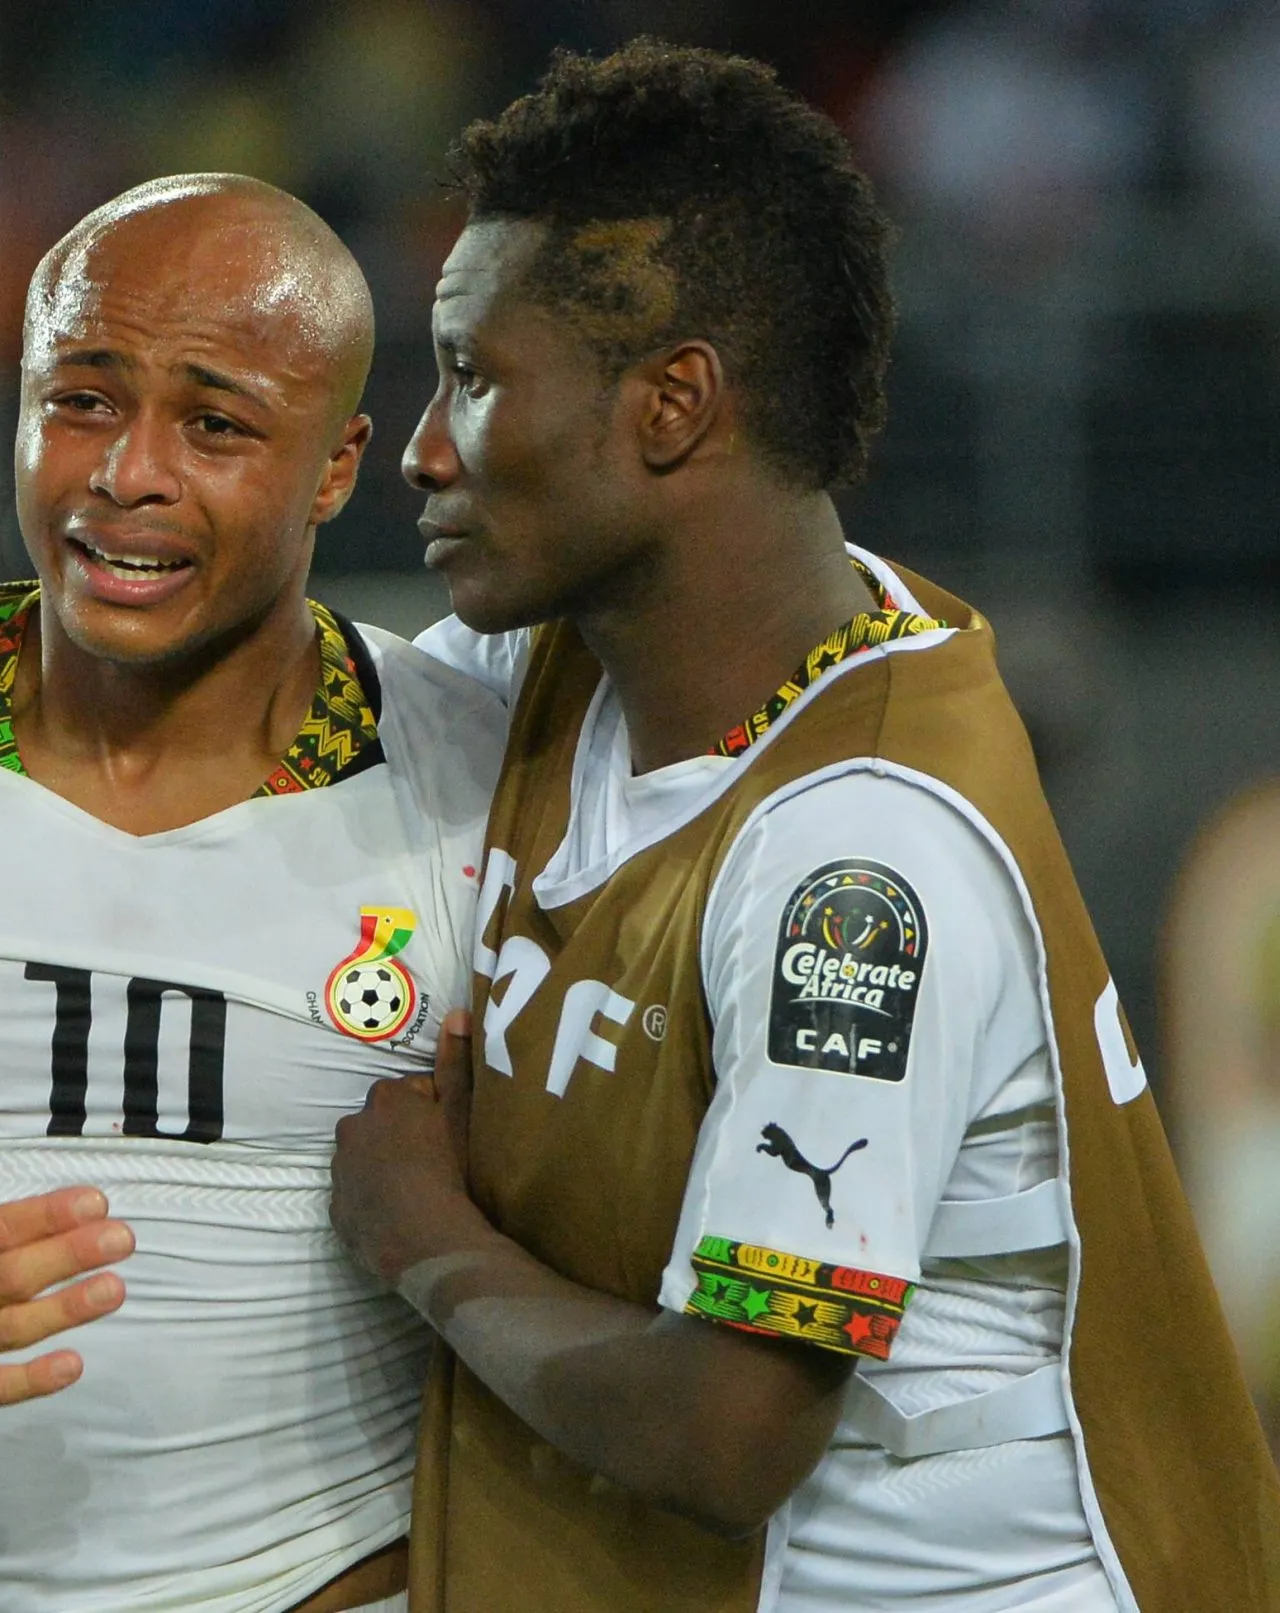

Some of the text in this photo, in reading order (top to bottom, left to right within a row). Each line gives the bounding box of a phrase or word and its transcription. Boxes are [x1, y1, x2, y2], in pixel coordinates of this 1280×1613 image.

[781, 942, 916, 991] Celebrate
[305, 991, 325, 1025] GHAN
[798, 974, 885, 1009] Africa
[389, 992, 430, 1051] ASOCIATION
[23, 961, 228, 1144] 10
[796, 1028, 883, 1060] CAF
